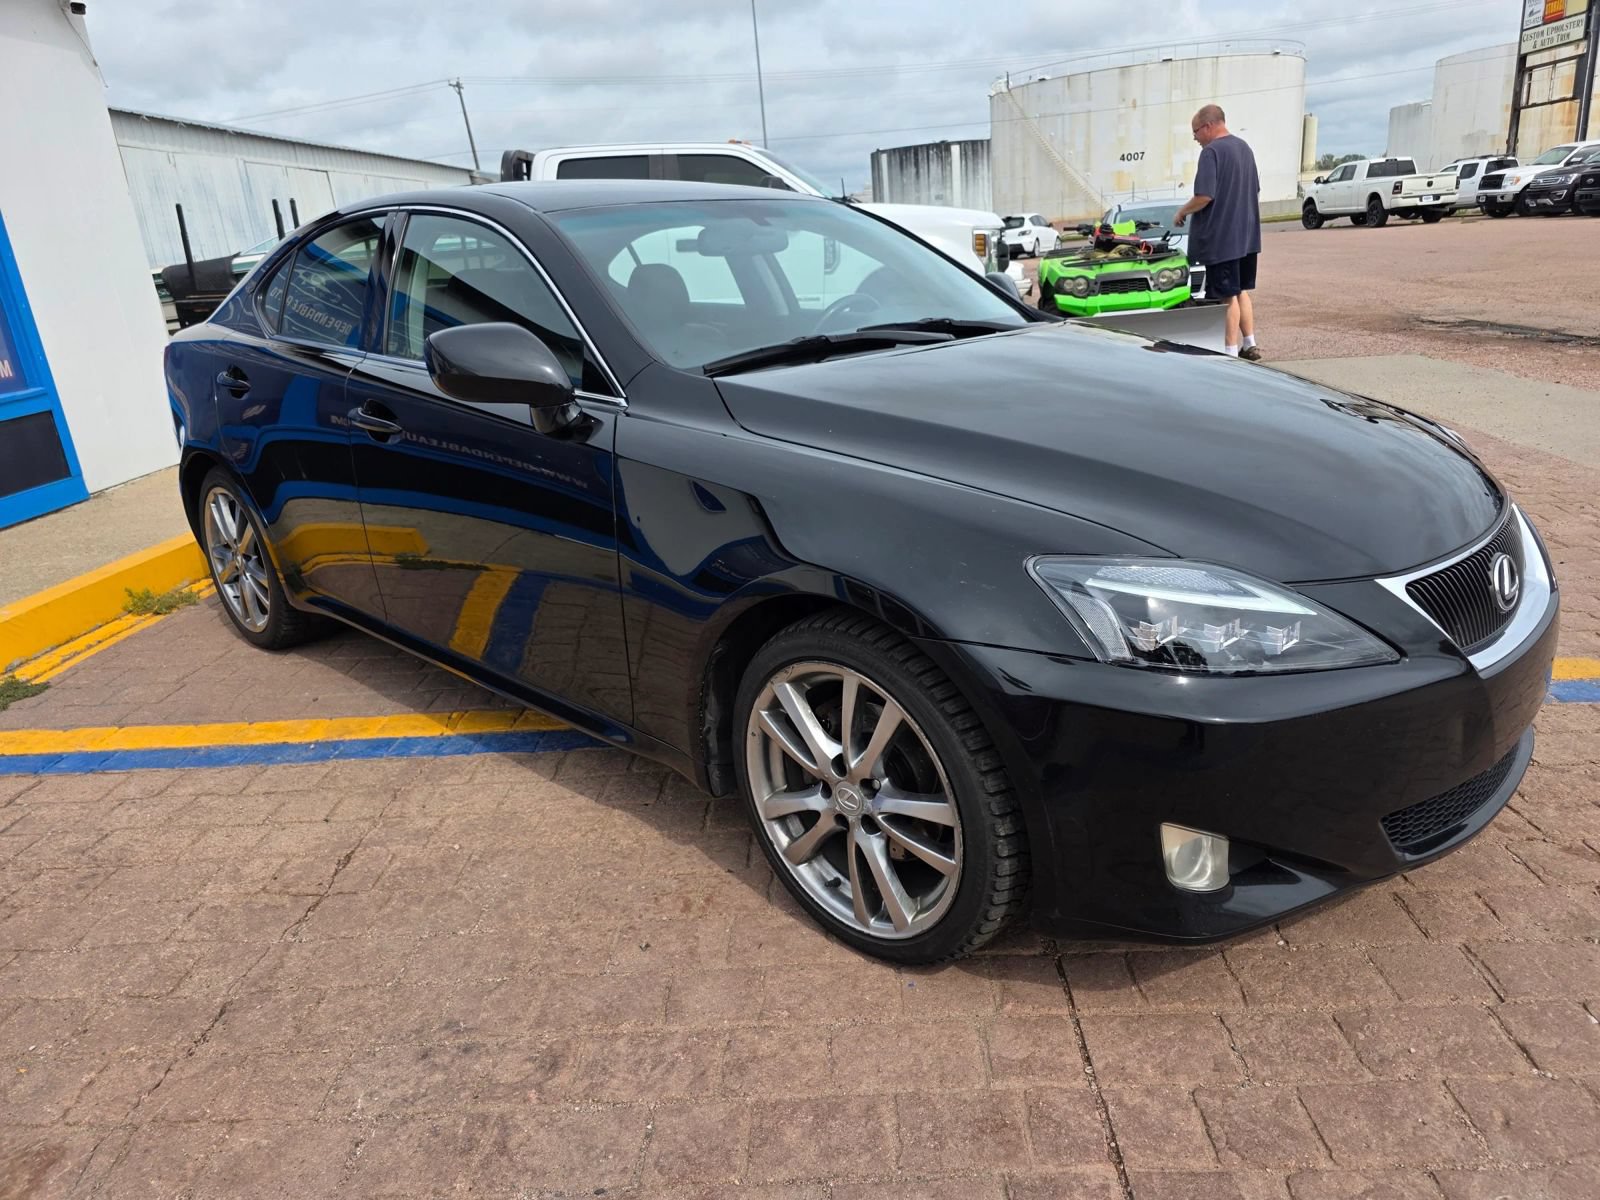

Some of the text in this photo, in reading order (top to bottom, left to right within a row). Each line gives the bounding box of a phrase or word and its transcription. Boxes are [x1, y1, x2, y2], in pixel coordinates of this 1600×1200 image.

[1522, 30, 1545, 43] CUSTOM
[1540, 36, 1554, 47] AUTO
[1119, 151, 1145, 162] 4007
